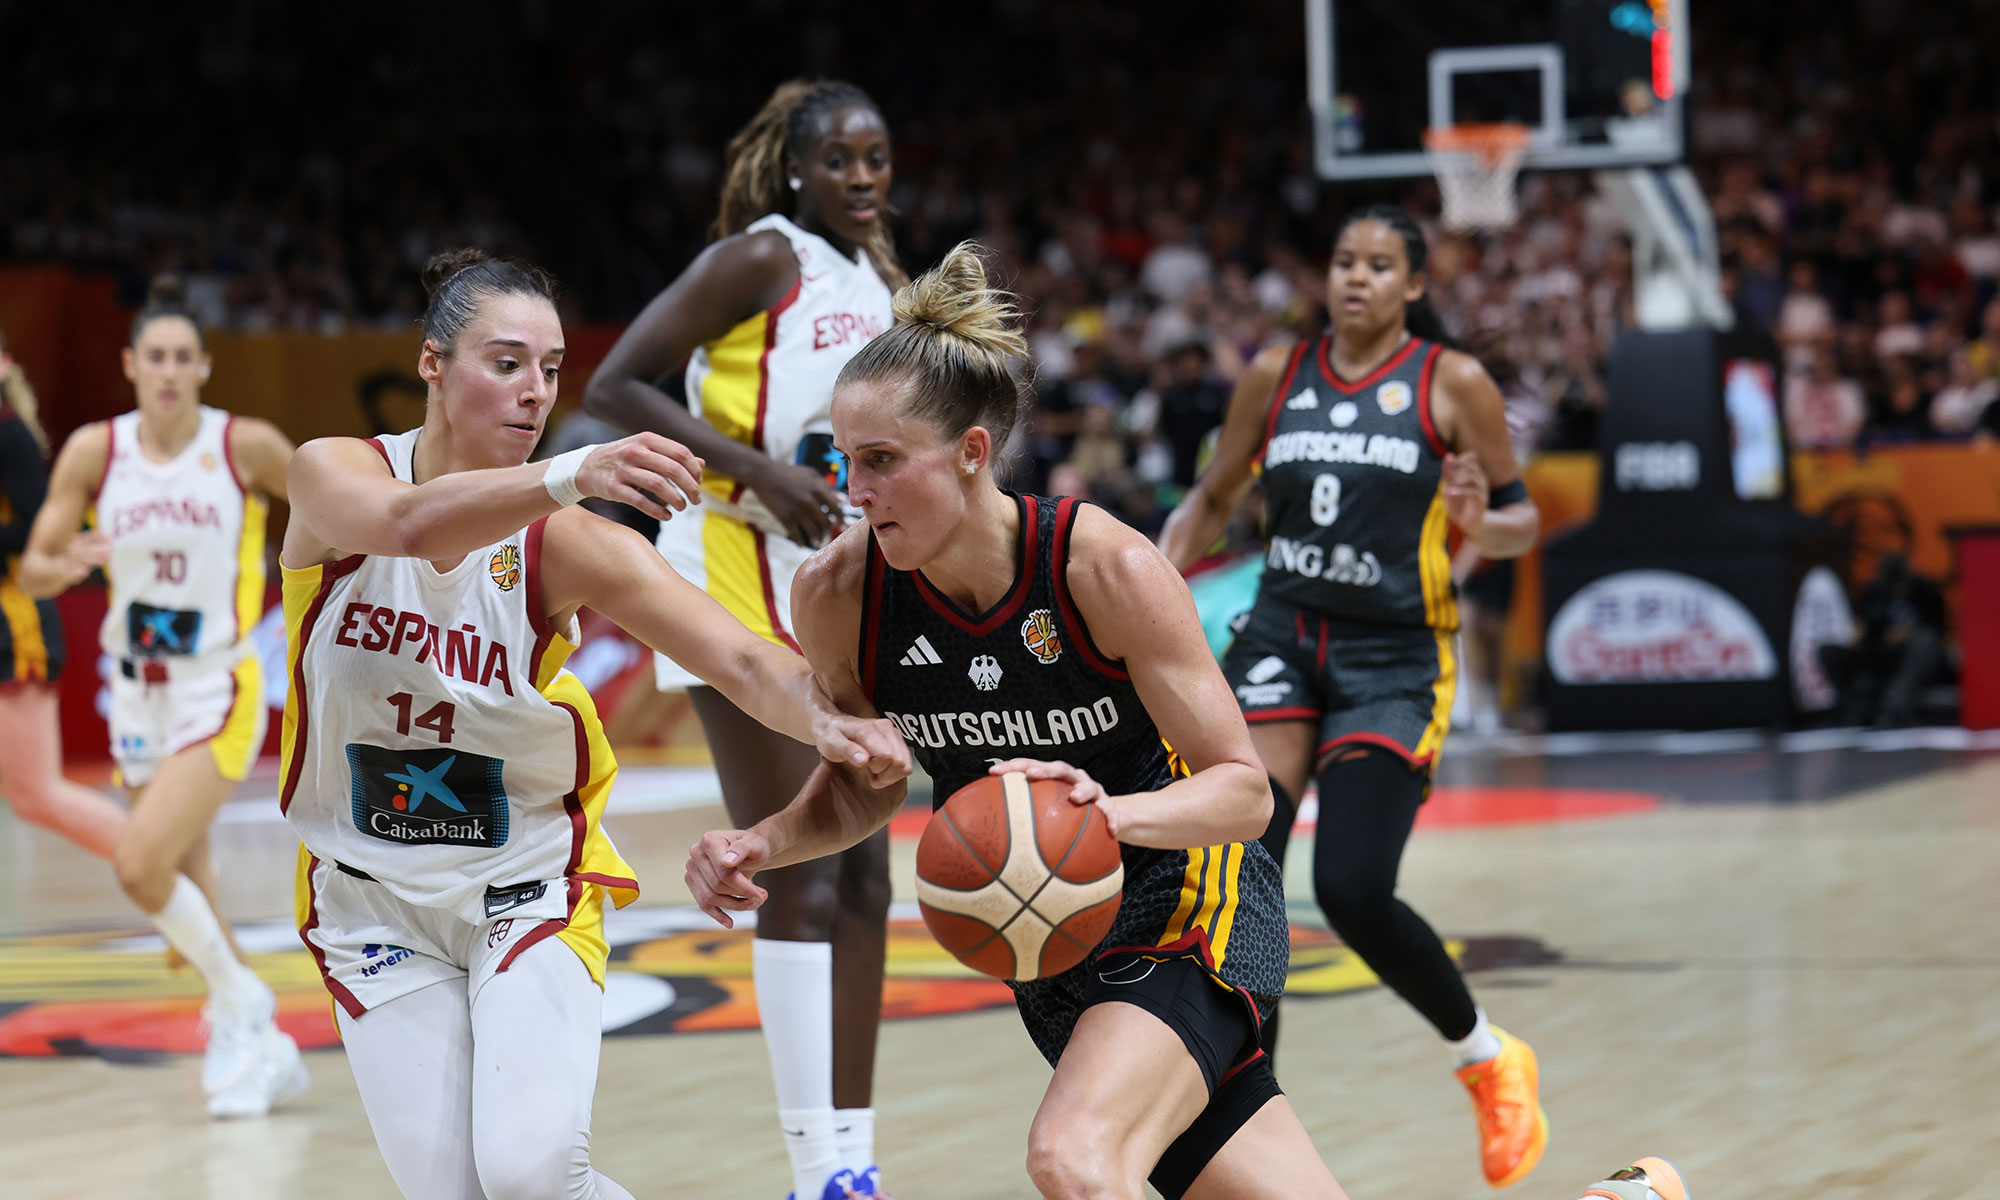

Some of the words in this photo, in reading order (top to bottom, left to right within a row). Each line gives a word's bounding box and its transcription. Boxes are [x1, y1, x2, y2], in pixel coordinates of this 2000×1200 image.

[1310, 473, 1341, 527] 8
[153, 551, 187, 585] 10
[336, 602, 514, 697] ESPAÑA
[386, 692, 456, 743] 14
[884, 696, 1119, 748] DEUTSCHLAND
[370, 812, 486, 840] CaixaBank
[520, 891, 534, 900] 46
